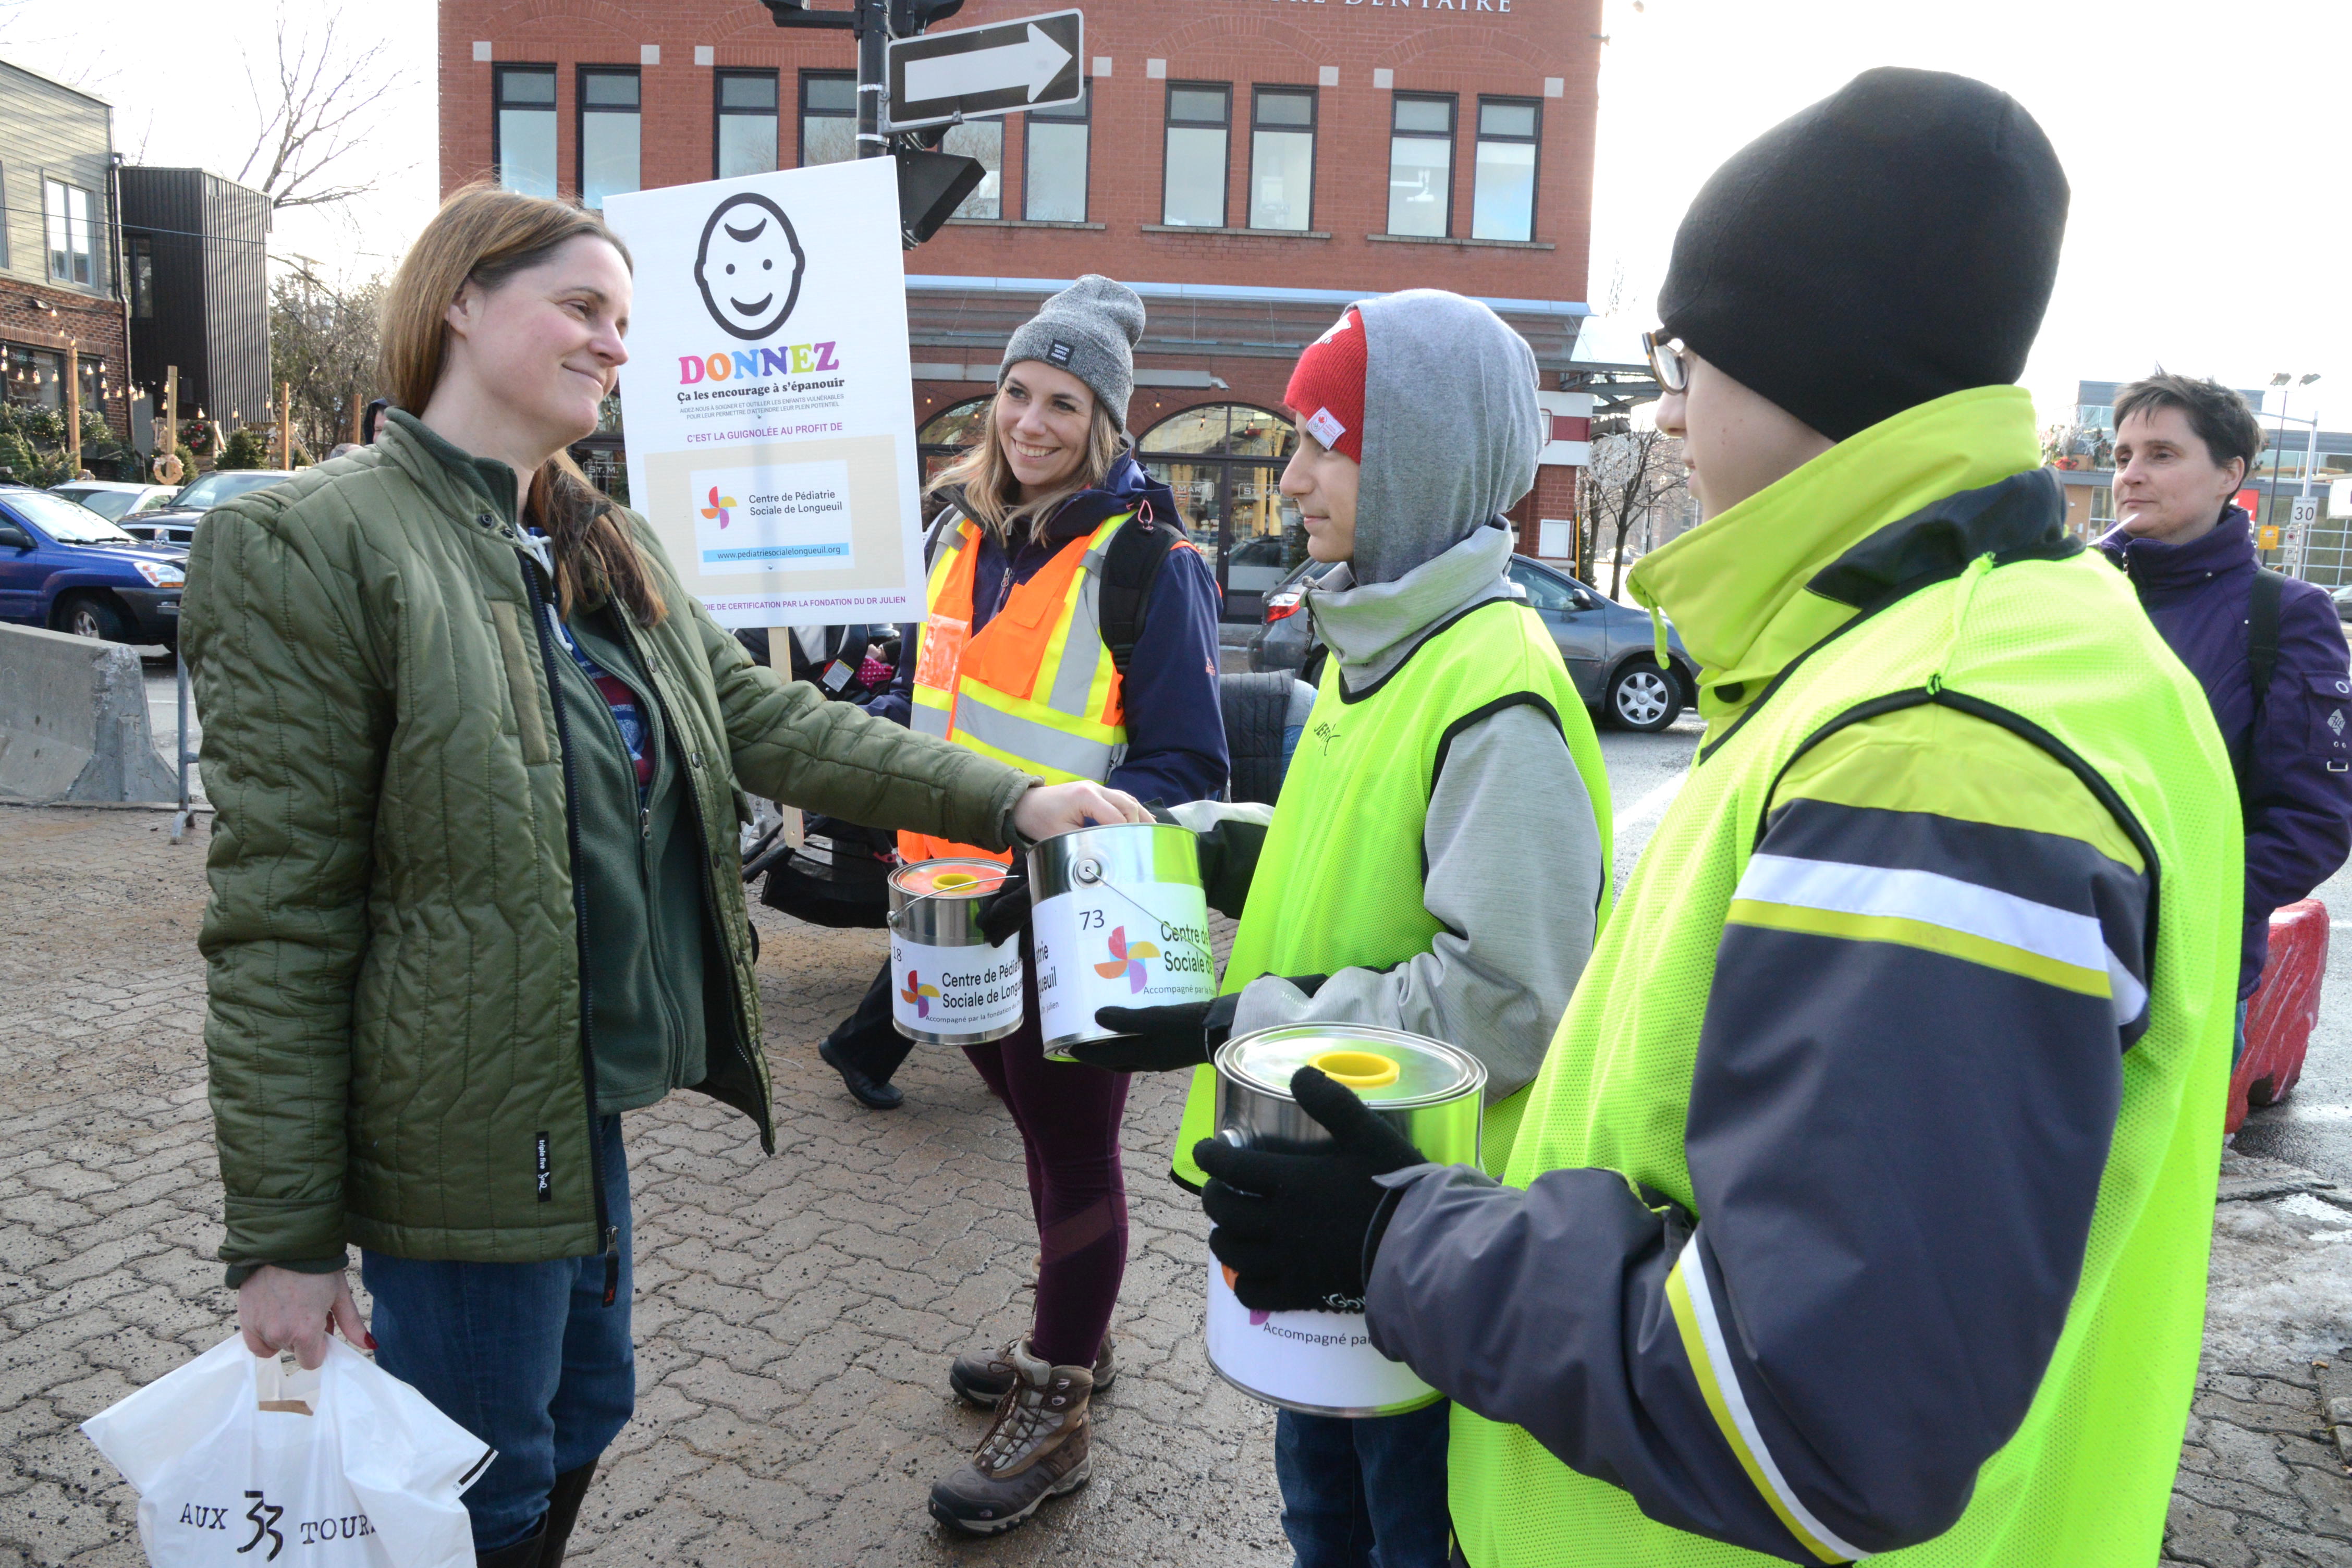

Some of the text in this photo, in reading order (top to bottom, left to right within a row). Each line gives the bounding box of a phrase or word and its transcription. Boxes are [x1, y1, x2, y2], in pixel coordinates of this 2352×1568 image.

[678, 341, 839, 385] DONNEZ
[677, 378, 845, 404] Ça les encourage à s'épanouir
[747, 406, 779, 414] D'ATTEINDRE
[687, 422, 843, 443] C'EST LA GUIGNOLÉE AU PROFIT DE
[749, 489, 836, 504] Centre de Pédiatrie
[750, 501, 842, 516] Sociale de Longueuil
[2294, 507, 2314, 520] 30
[717, 546, 840, 559] www.pediatriesocialelongueuil.org
[728, 601, 781, 610] CERTIFICATION
[1079, 909, 1105, 930] 73
[1161, 921, 1208, 946] Centre de
[893, 946, 902, 962] 18
[1164, 950, 1212, 976] Sociale de
[942, 972, 981, 987] Centre
[984, 968, 996, 984] de
[942, 991, 984, 1008] Sociale
[987, 989, 999, 1003] de
[1143, 985, 1193, 995] Accompagné
[925, 1015, 966, 1024] Accompagné
[987, 1006, 1011, 1019] fondation
[1046, 1001, 1059, 1013] julien
[1263, 1322, 1346, 1346] Accompagné
[179, 1490, 377, 1562] AUX 33 TOUR
